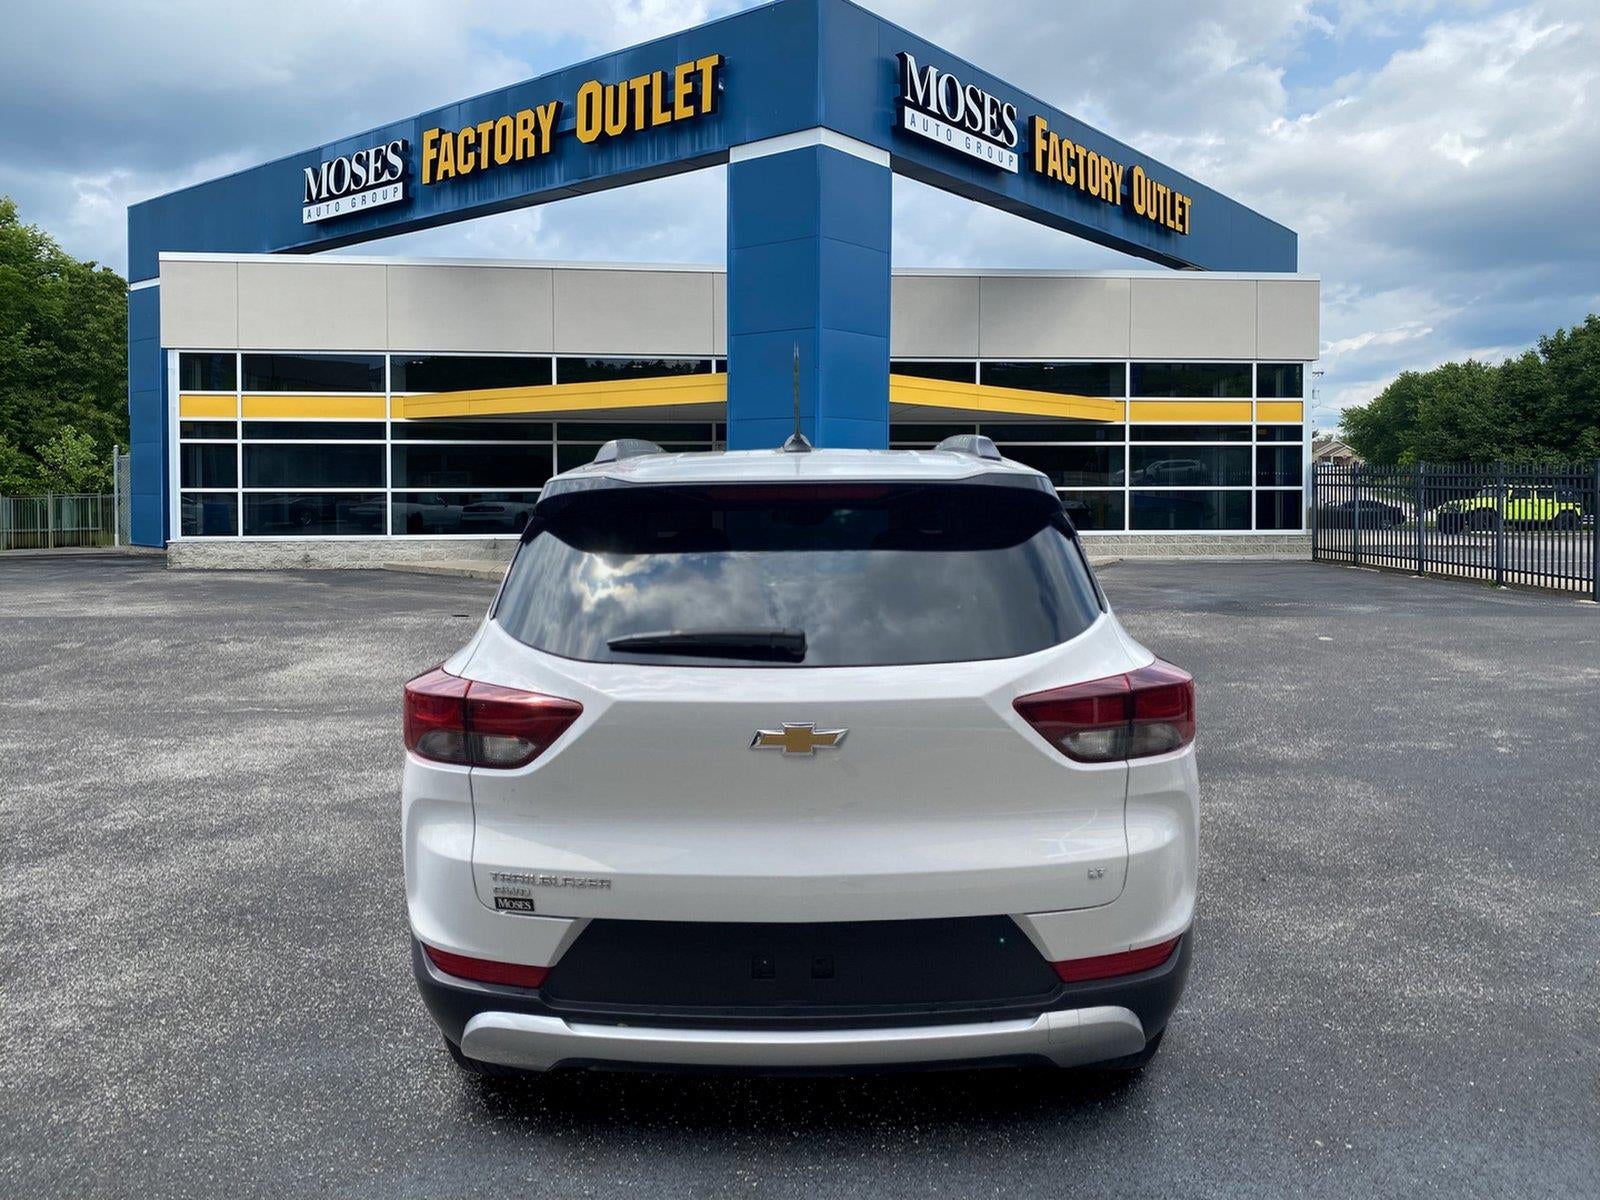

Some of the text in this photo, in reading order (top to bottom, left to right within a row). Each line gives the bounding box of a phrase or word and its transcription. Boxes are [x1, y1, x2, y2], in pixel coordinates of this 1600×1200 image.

[422, 54, 720, 184] FACTORY OUTLET
[903, 52, 1018, 148] MOSES
[910, 113, 1015, 167] AUTO GROUP
[302, 140, 404, 204] MOSES
[1034, 115, 1192, 235] FACTORY OUTLET
[306, 186, 399, 220] AUTO GROUP
[490, 871, 612, 889] TRAILBLAZER
[498, 898, 531, 910] MOSES
